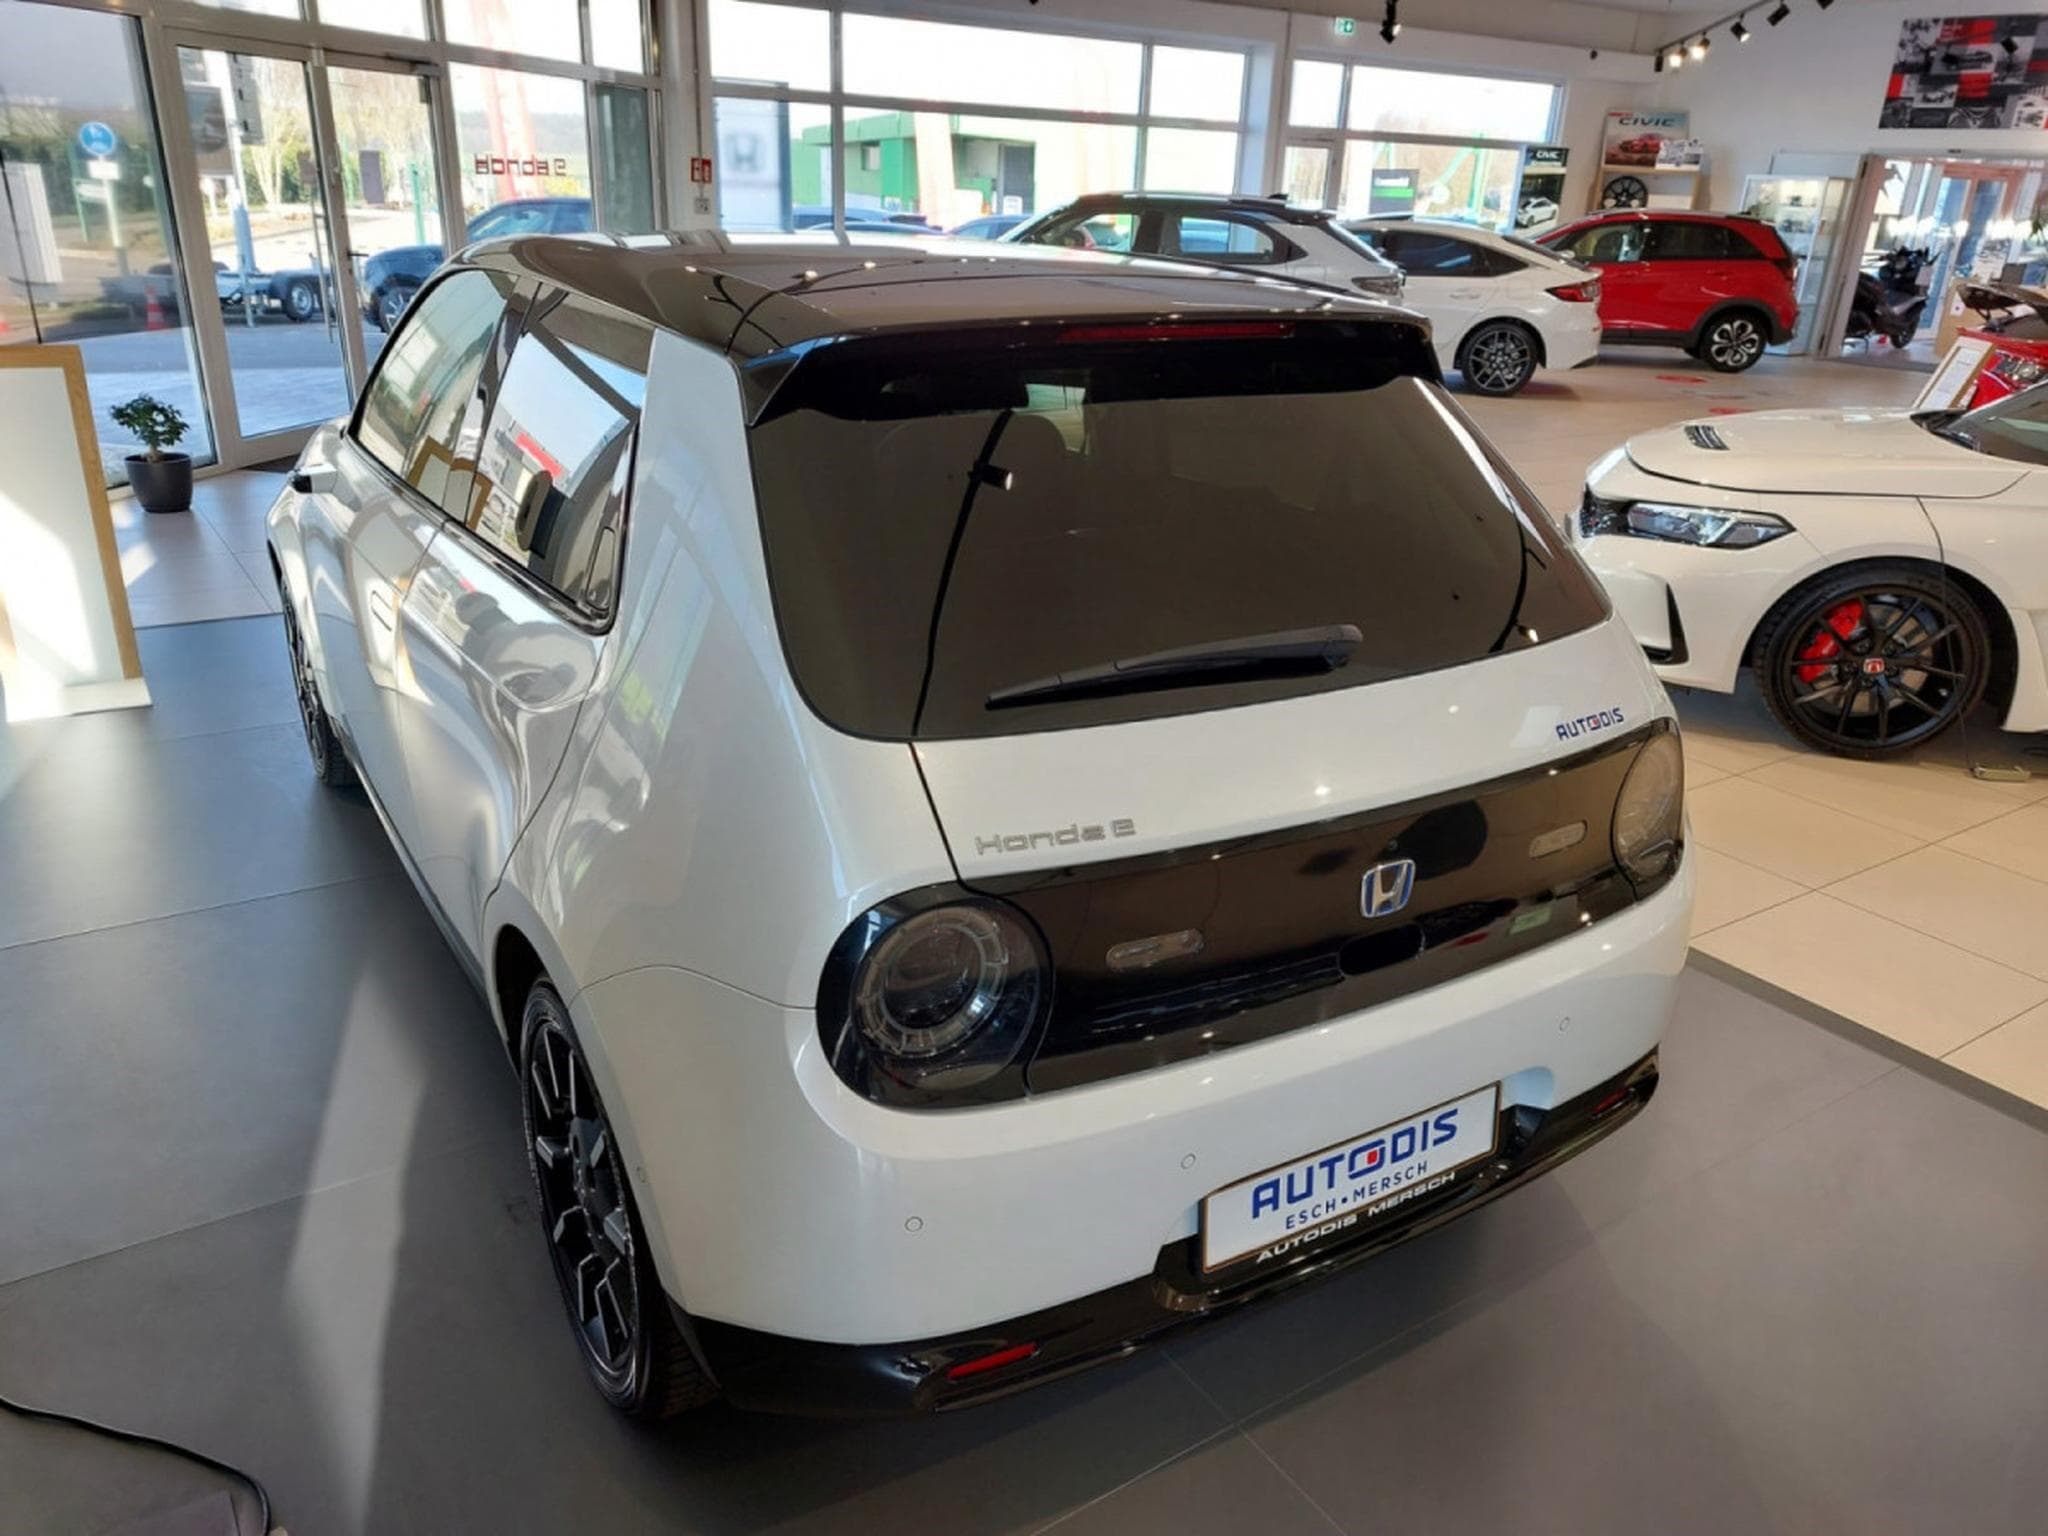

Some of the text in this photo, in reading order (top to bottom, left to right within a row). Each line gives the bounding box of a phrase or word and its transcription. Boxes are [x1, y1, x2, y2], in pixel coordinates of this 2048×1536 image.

[1618, 117, 1676, 127] CIVIC
[1556, 707, 1625, 741] AUTODIS
[974, 824, 1106, 856] Honda
[1252, 1108, 1458, 1219] AUTODIS
[1256, 1171, 1456, 1264] AUTODIS MERSCH
